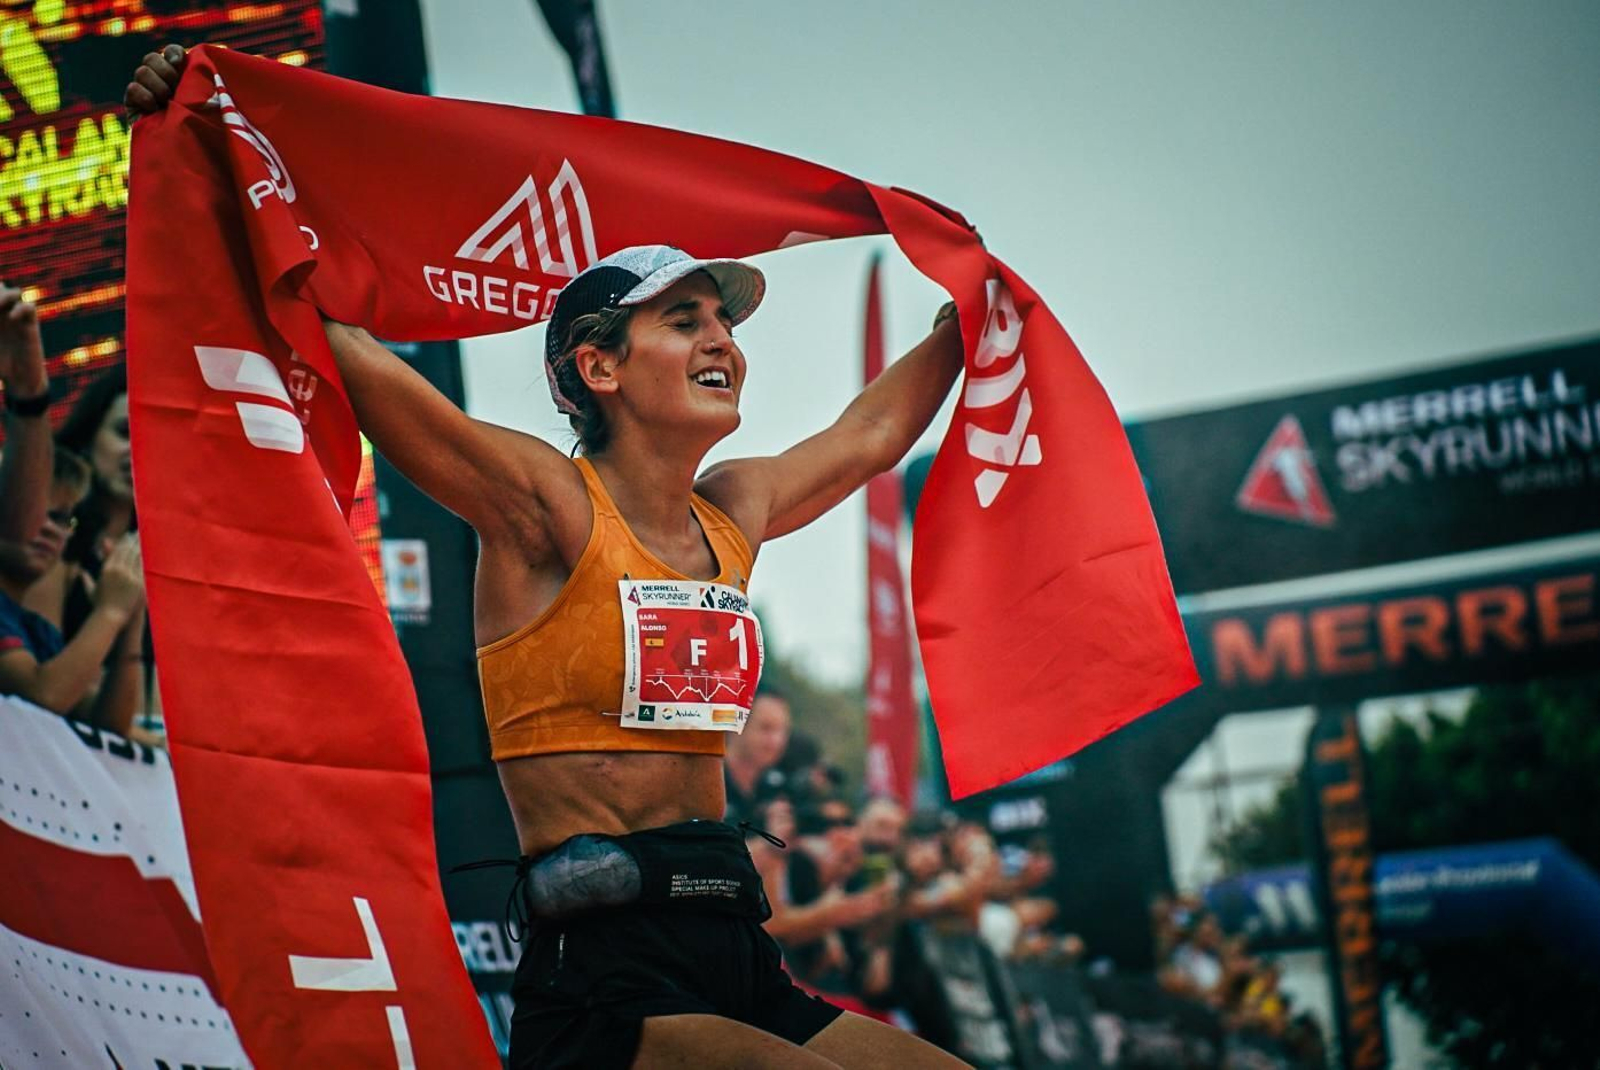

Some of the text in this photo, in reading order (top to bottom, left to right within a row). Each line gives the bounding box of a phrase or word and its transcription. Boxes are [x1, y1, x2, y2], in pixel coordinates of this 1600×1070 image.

[422, 265, 566, 321] GREGO
[1331, 369, 1587, 440] MERRELL
[1336, 400, 1600, 492] SKYRUNN
[690, 638, 708, 666] F
[729, 617, 748, 671] 1
